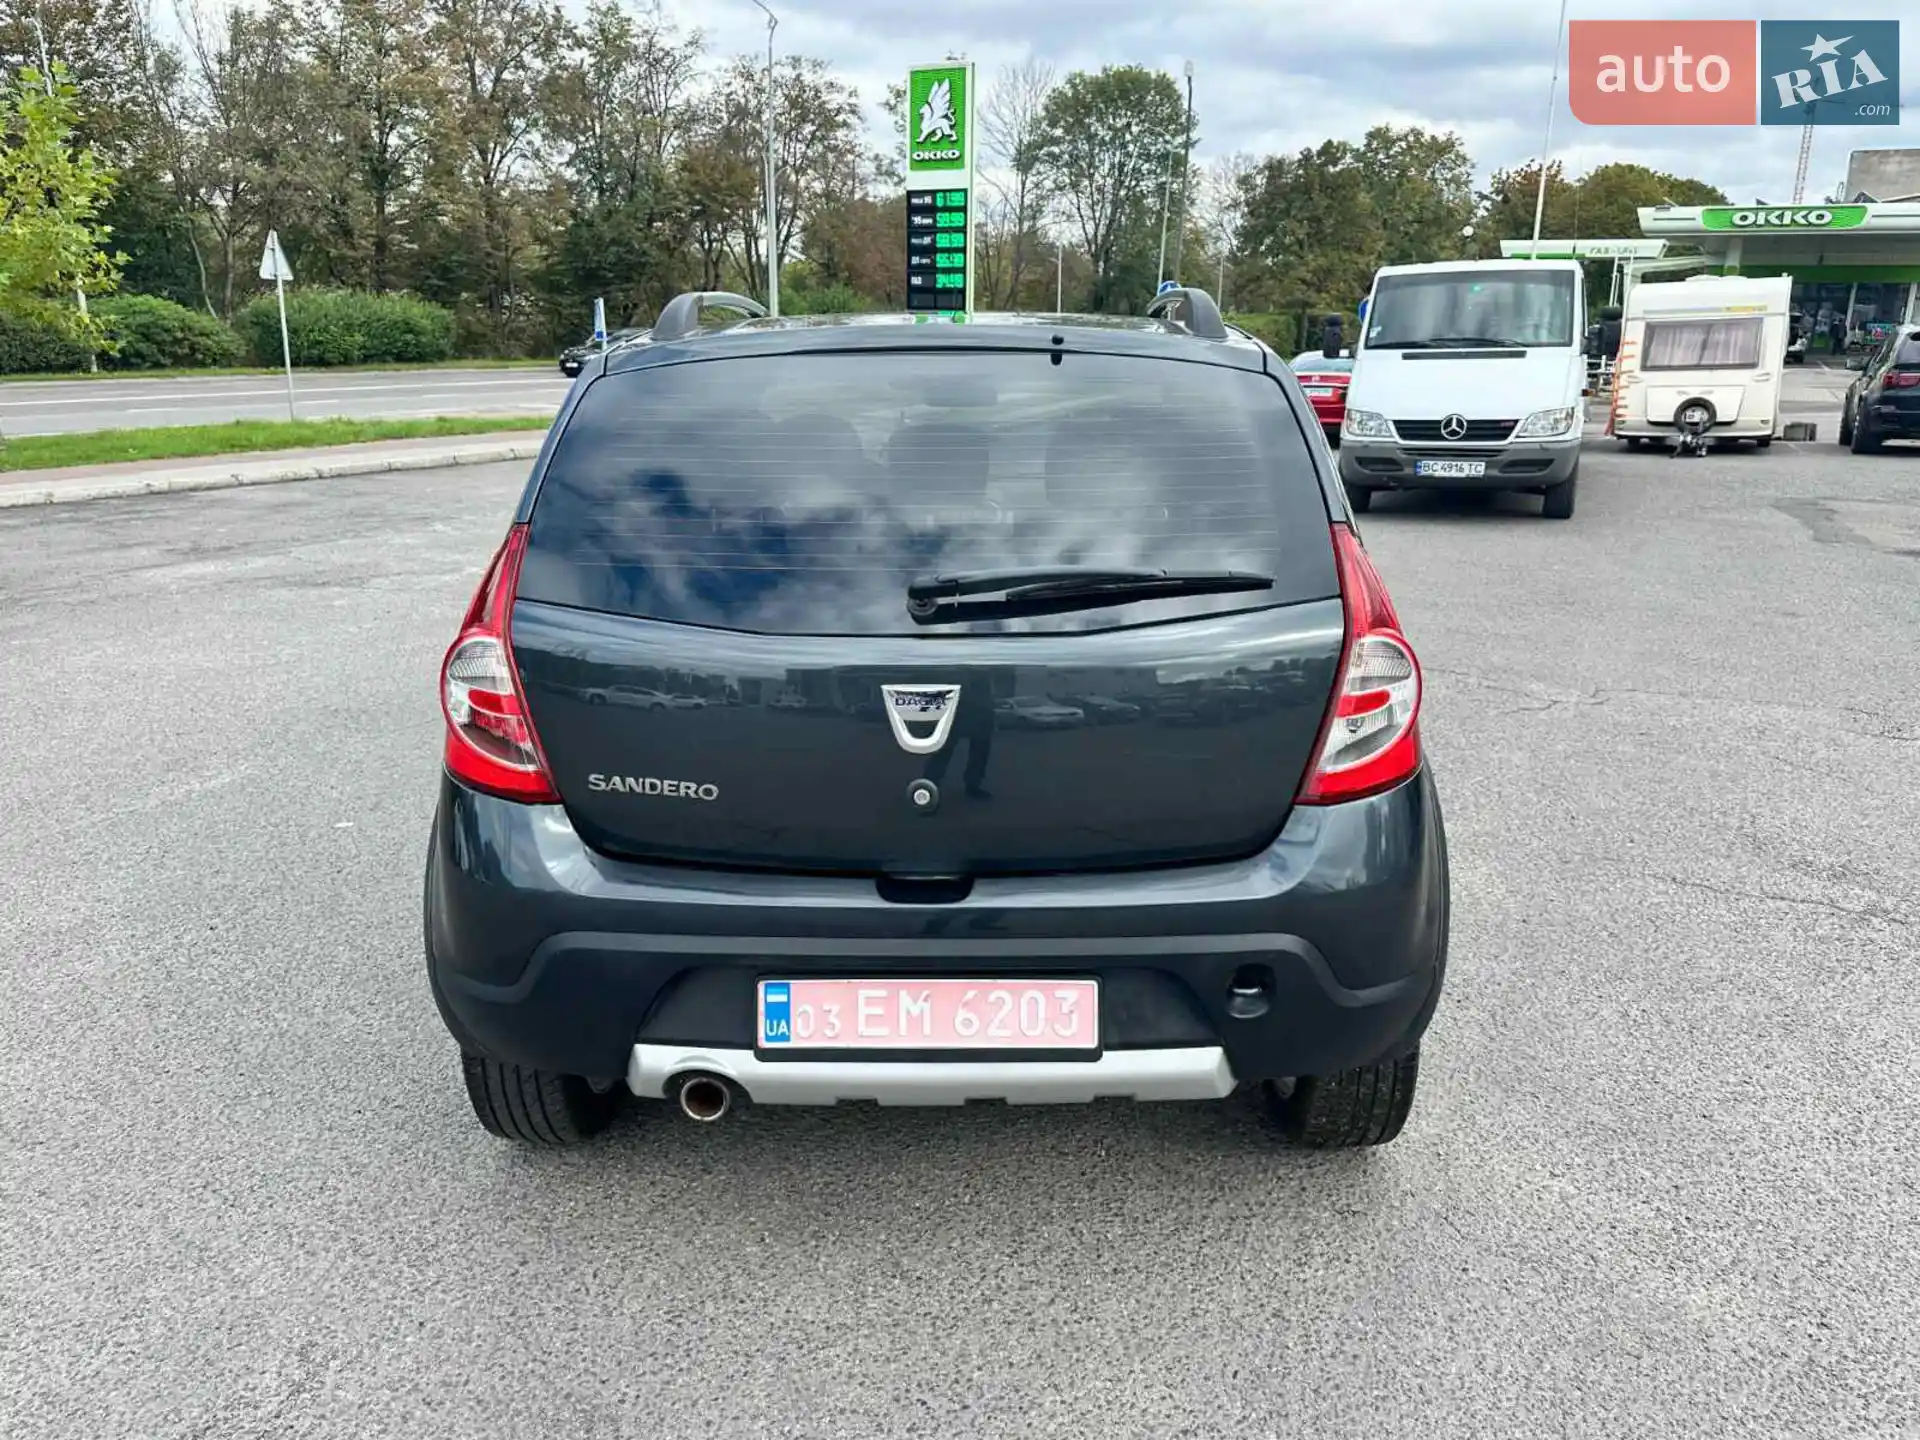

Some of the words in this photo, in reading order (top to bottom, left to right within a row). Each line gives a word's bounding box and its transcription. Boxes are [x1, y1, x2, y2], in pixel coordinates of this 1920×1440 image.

[911, 149, 961, 161] OKKO
[1731, 209, 1833, 226] OKKO
[1422, 462, 1439, 473] BC
[1440, 462, 1465, 474] 4916
[1467, 463, 1483, 474] TC
[587, 773, 720, 800] SANDERO
[795, 1004, 841, 1039] 03
[857, 989, 931, 1036] EM
[953, 990, 1079, 1038] 6203
[766, 1019, 789, 1036] UA
